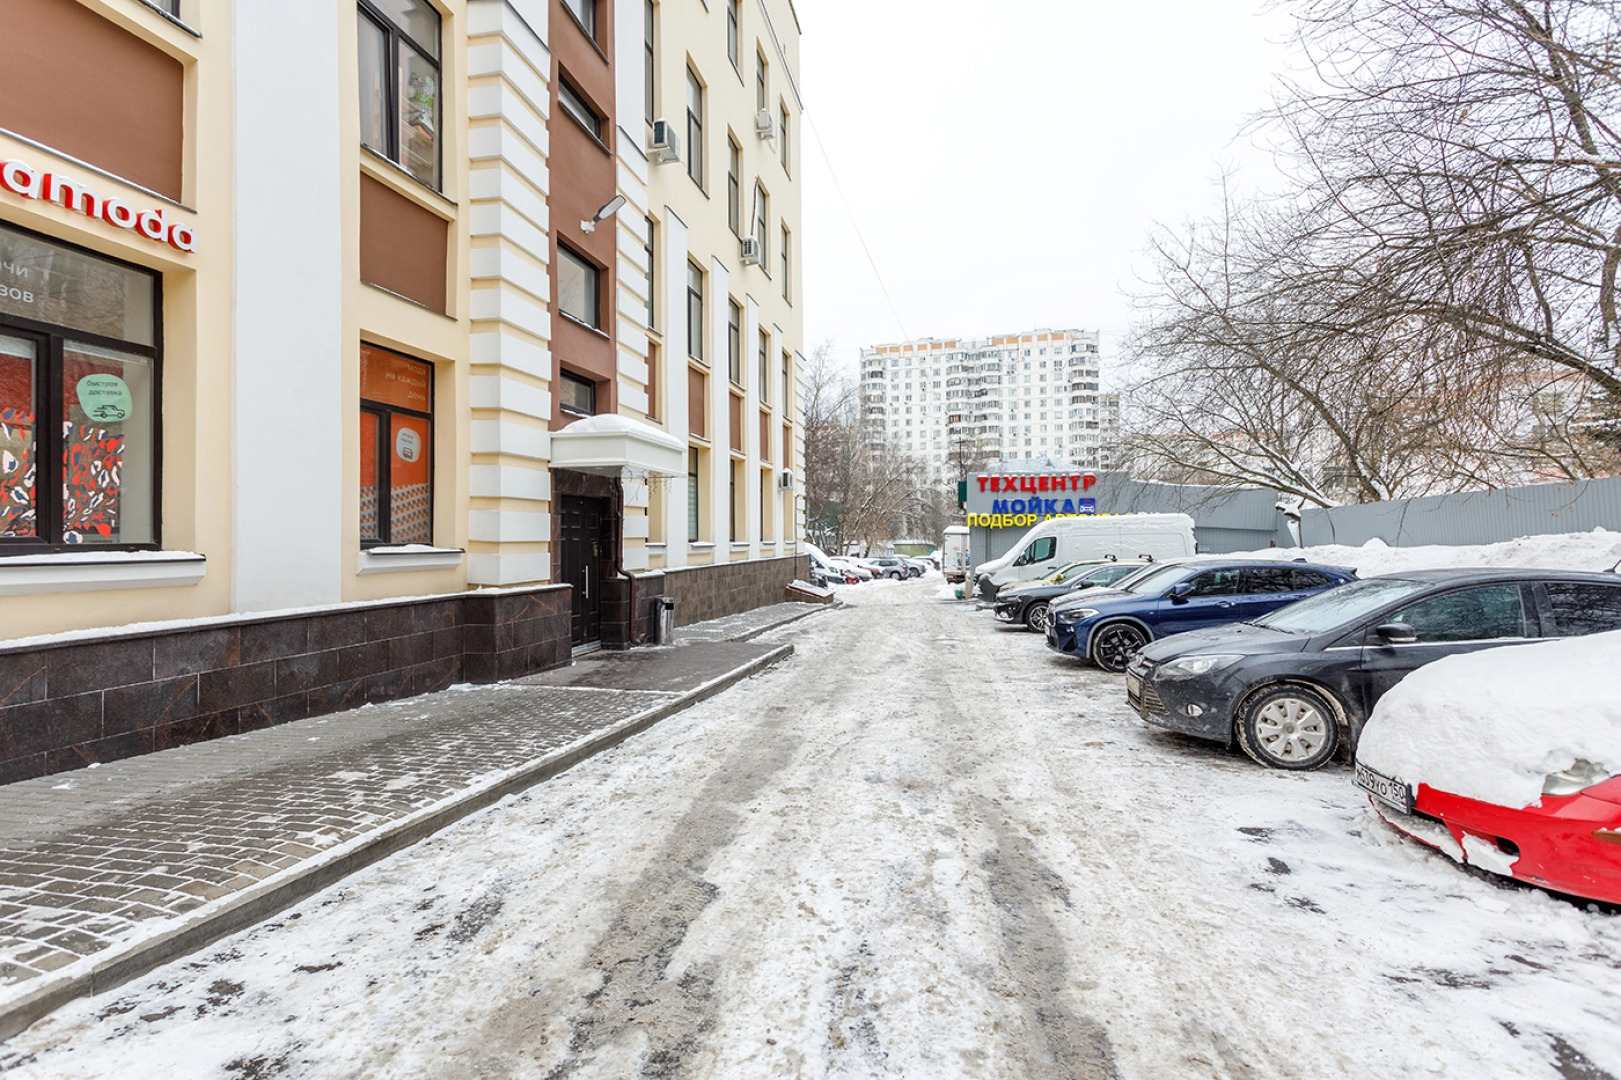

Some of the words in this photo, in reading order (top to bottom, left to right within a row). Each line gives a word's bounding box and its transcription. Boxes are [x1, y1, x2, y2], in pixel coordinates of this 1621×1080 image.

[0, 260, 28, 278] чи
[976, 474, 1097, 494] ТЕХЦЕНТР
[992, 496, 1076, 514] МОЙКА
[967, 513, 1038, 530] ПОДБОР
[1388, 782, 1404, 800] 150
